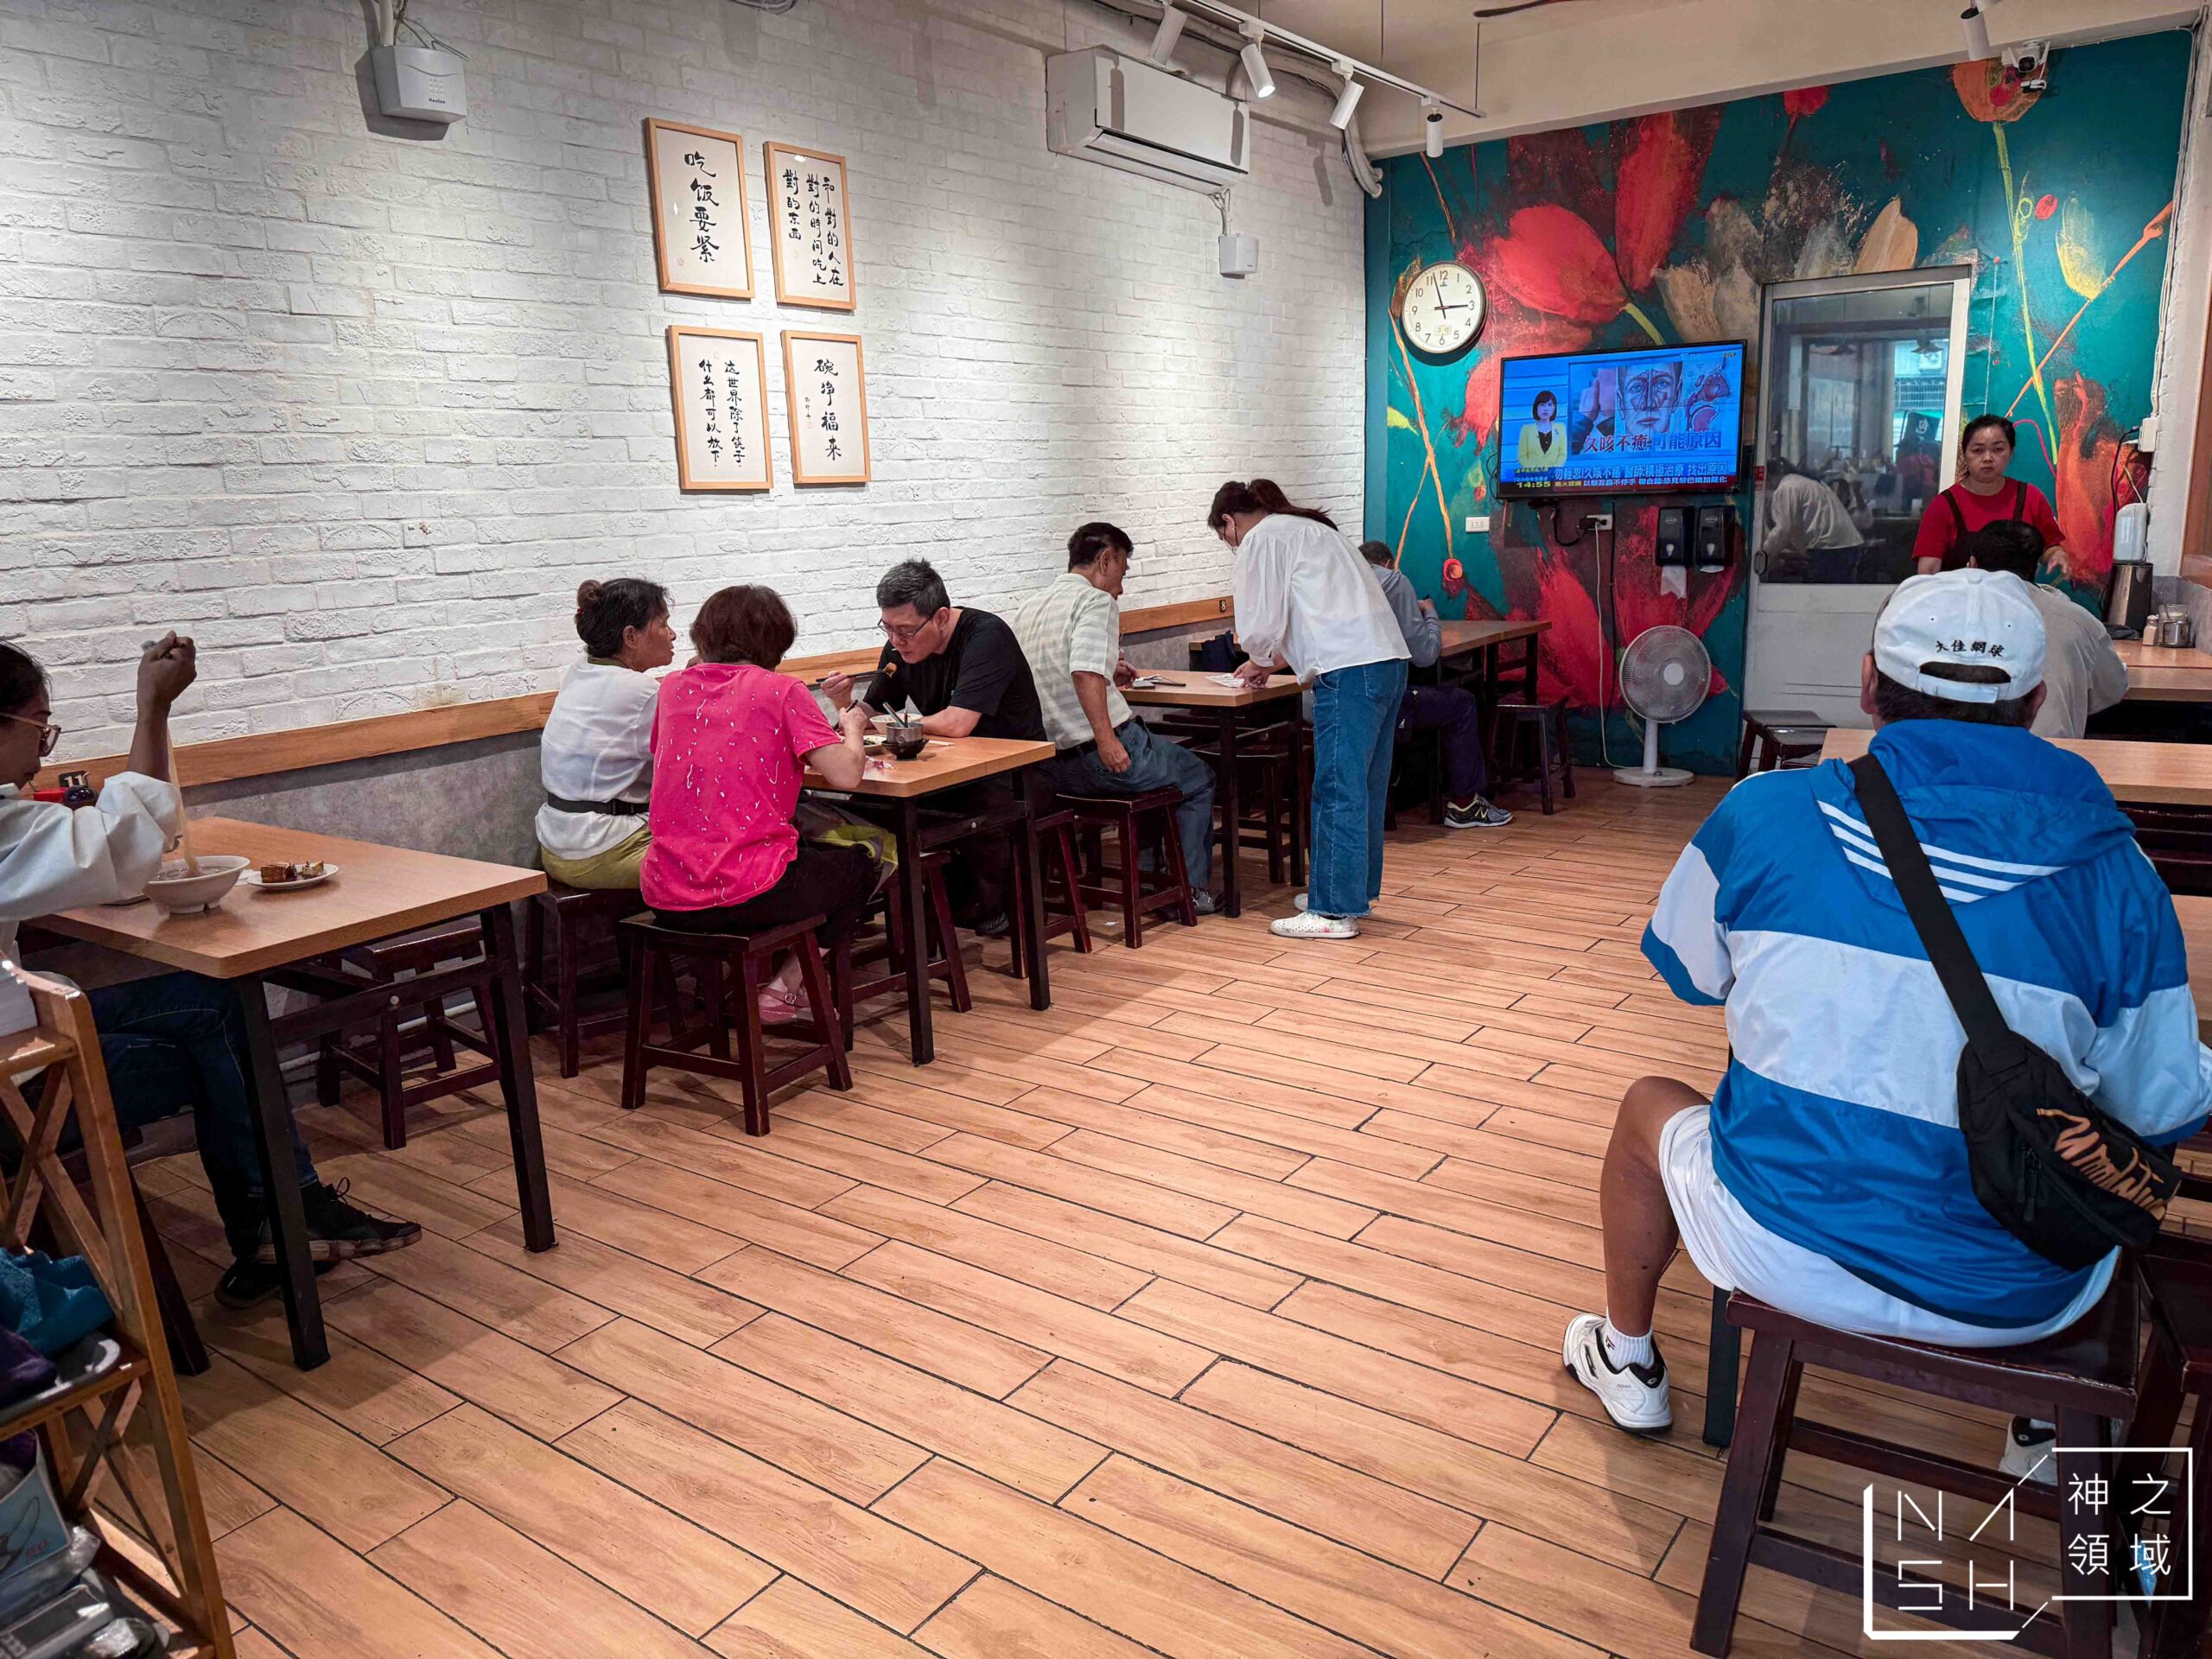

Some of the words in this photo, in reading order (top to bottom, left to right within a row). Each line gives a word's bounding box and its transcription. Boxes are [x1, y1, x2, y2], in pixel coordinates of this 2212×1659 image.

[684, 150, 720, 263] 吃饭要紧
[1440, 270, 1448, 281] 12
[1427, 276, 1433, 285] 11
[1415, 288, 1424, 297] 10
[1466, 285, 1471, 294] 2
[1469, 300, 1475, 310] 3
[1412, 306, 1418, 315] 9
[1415, 322, 1421, 332] 8
[1465, 318, 1471, 327] 4
[1425, 333, 1432, 343] 7
[1440, 334, 1445, 345] 6
[1454, 331, 1459, 340] 5
[1221, 601, 1226, 610] 8
[64, 774, 85, 788] 11
